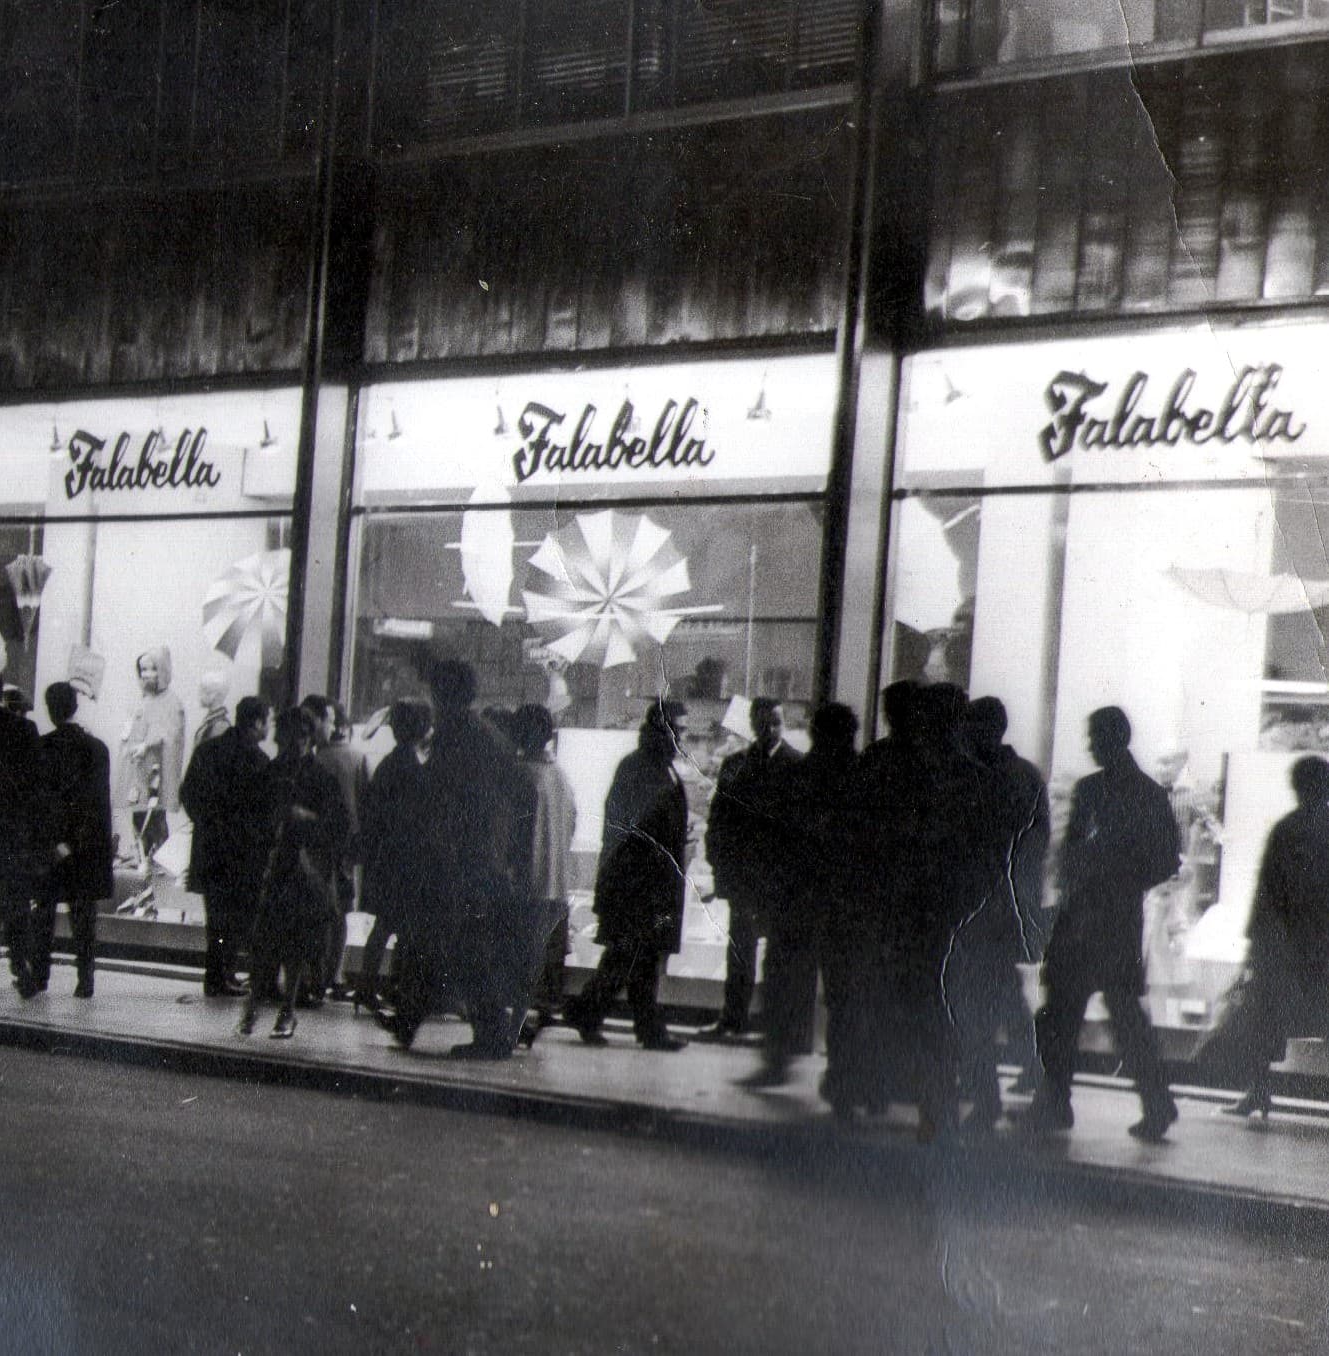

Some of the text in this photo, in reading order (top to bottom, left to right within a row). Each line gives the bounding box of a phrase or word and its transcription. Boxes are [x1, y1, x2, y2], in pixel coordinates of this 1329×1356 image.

[512, 396, 715, 483] Falabella
[1037, 362, 1307, 463] Falabella
[65, 427, 221, 500] Falabella
